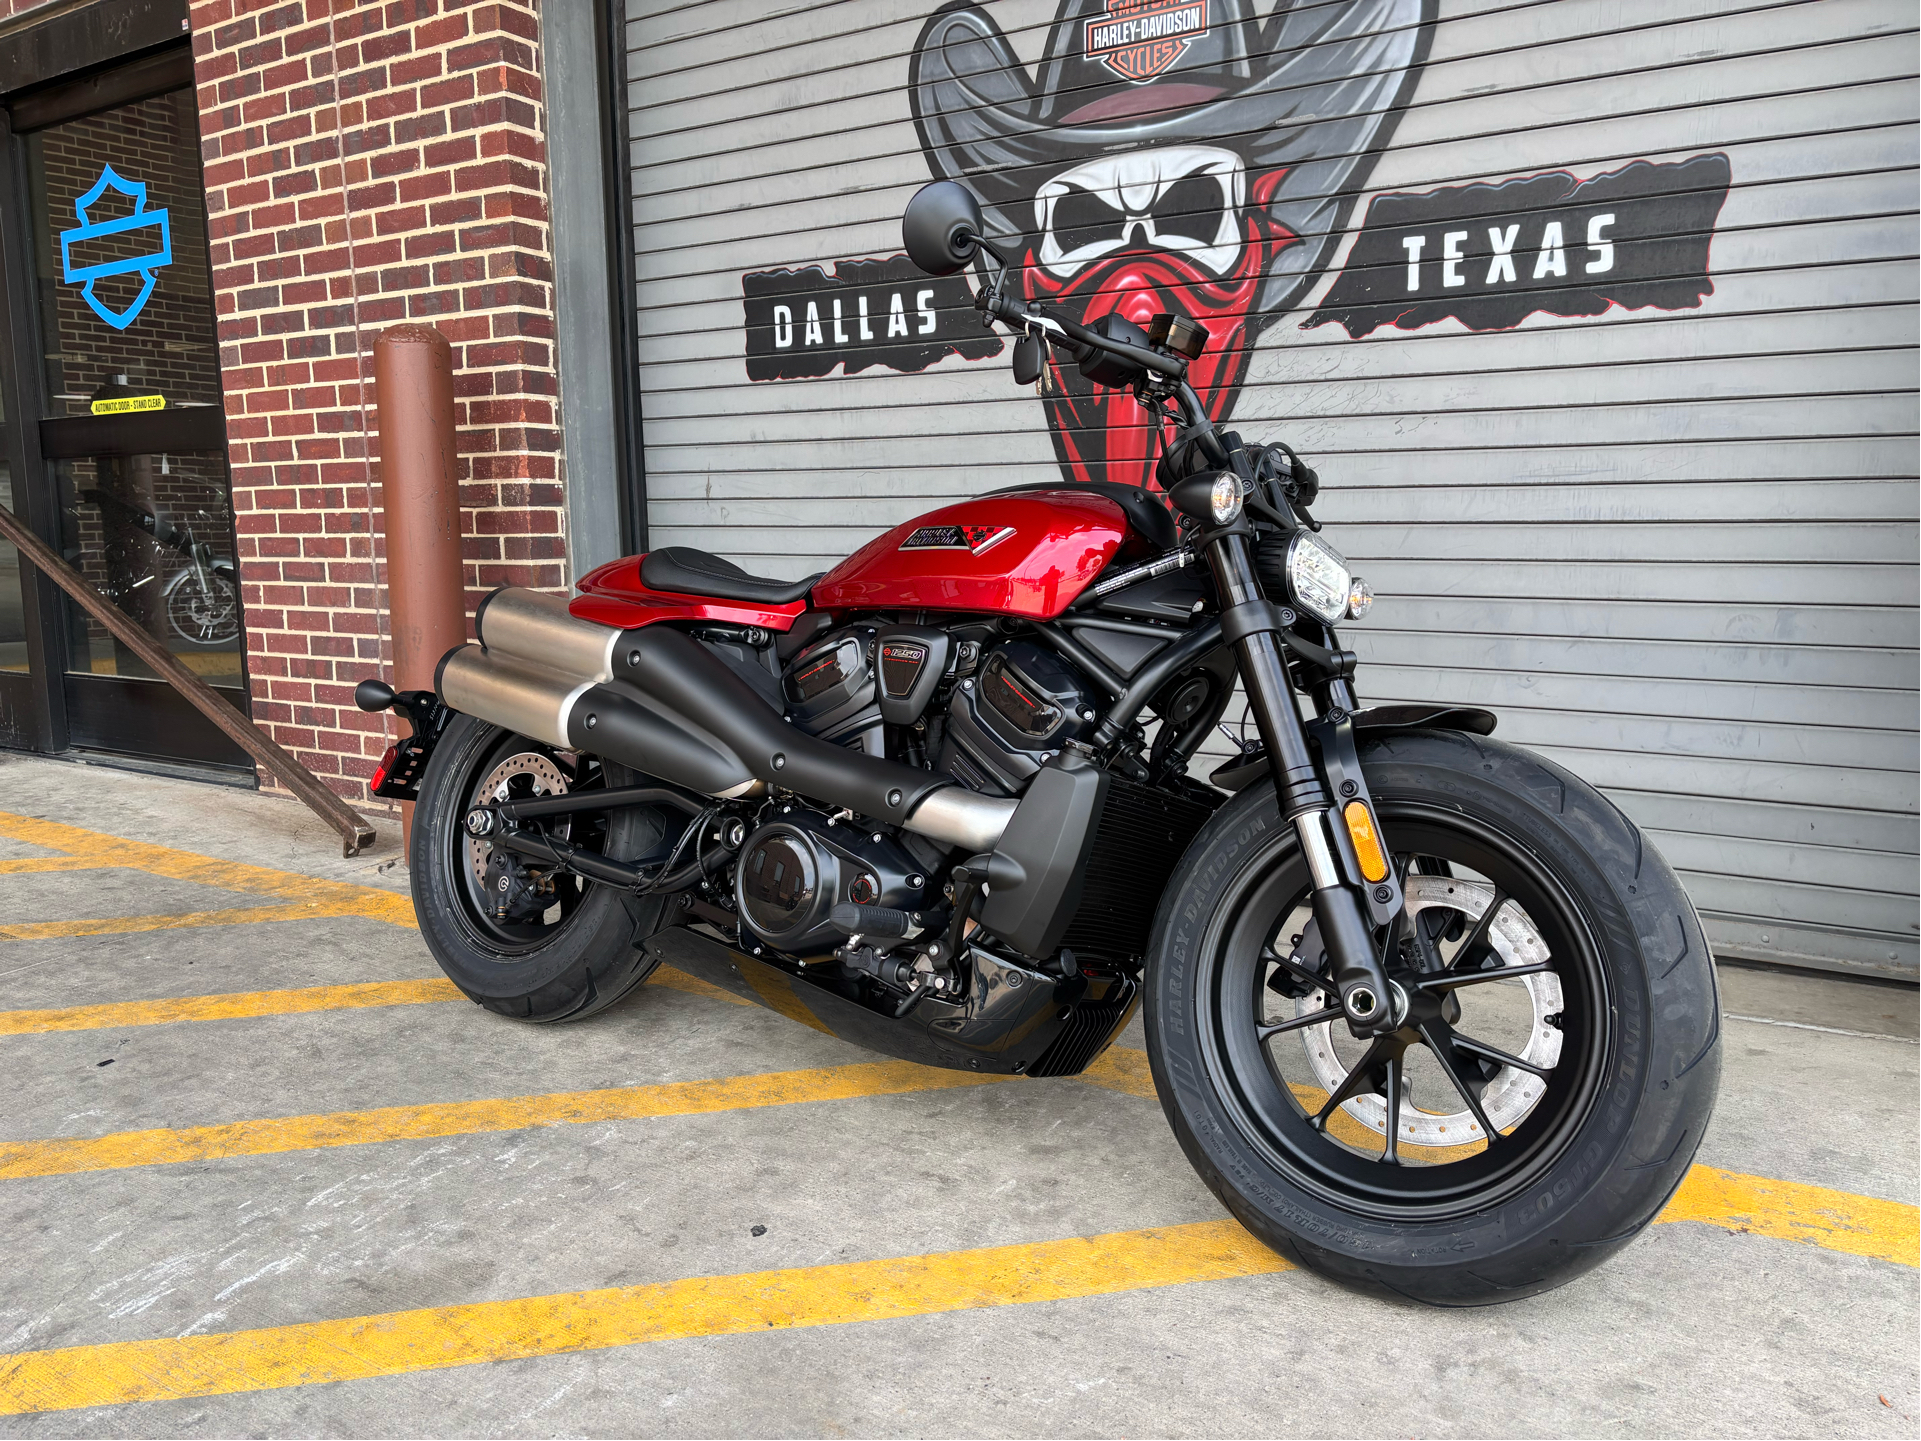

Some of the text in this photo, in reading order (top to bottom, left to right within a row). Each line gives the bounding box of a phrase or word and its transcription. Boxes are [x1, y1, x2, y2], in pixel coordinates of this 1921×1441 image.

[1093, 6, 1200, 49] HARLEY-DAVIDSON
[1116, 41, 1173, 75] CYCLES
[1402, 213, 1616, 292] TEXAS
[773, 289, 937, 348] DALLAS
[95, 402, 118, 412] AUTOMATIC
[118, 401, 130, 410] DOOR
[133, 399, 147, 409] STAND
[148, 398, 162, 408] CLEAR
[1168, 815, 1266, 1035] HARLEY-DAVIDSON
[1604, 984, 1643, 1136] DUNLOP
[1516, 1139, 1603, 1225] GT503
